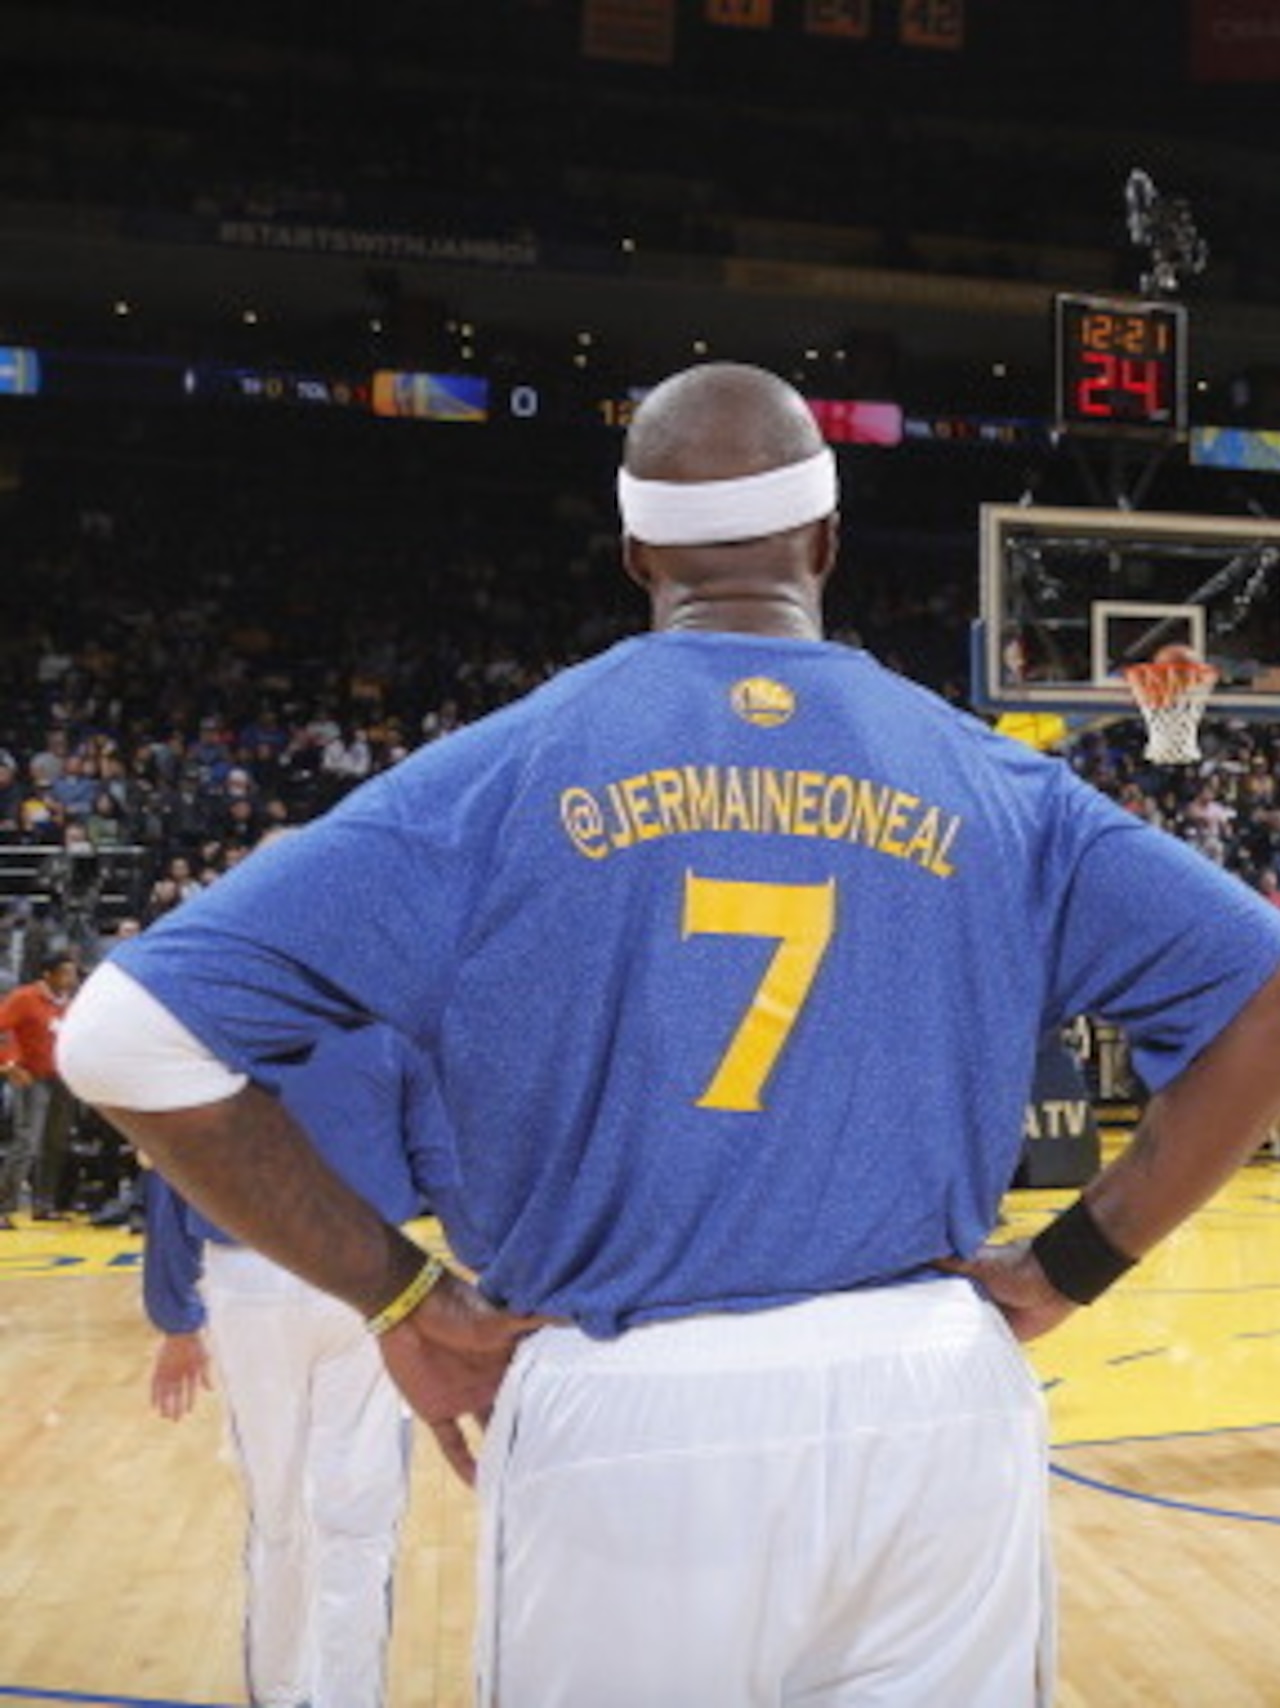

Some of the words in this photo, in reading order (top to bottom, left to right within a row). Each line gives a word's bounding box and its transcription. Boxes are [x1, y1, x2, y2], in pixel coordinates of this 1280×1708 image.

[1080, 314, 1166, 353] 12:21
[510, 386, 538, 417] 0
[1076, 352, 1158, 416] 24
[560, 765, 961, 878] @JERMAINEONEAL
[682, 867, 836, 1112] 7
